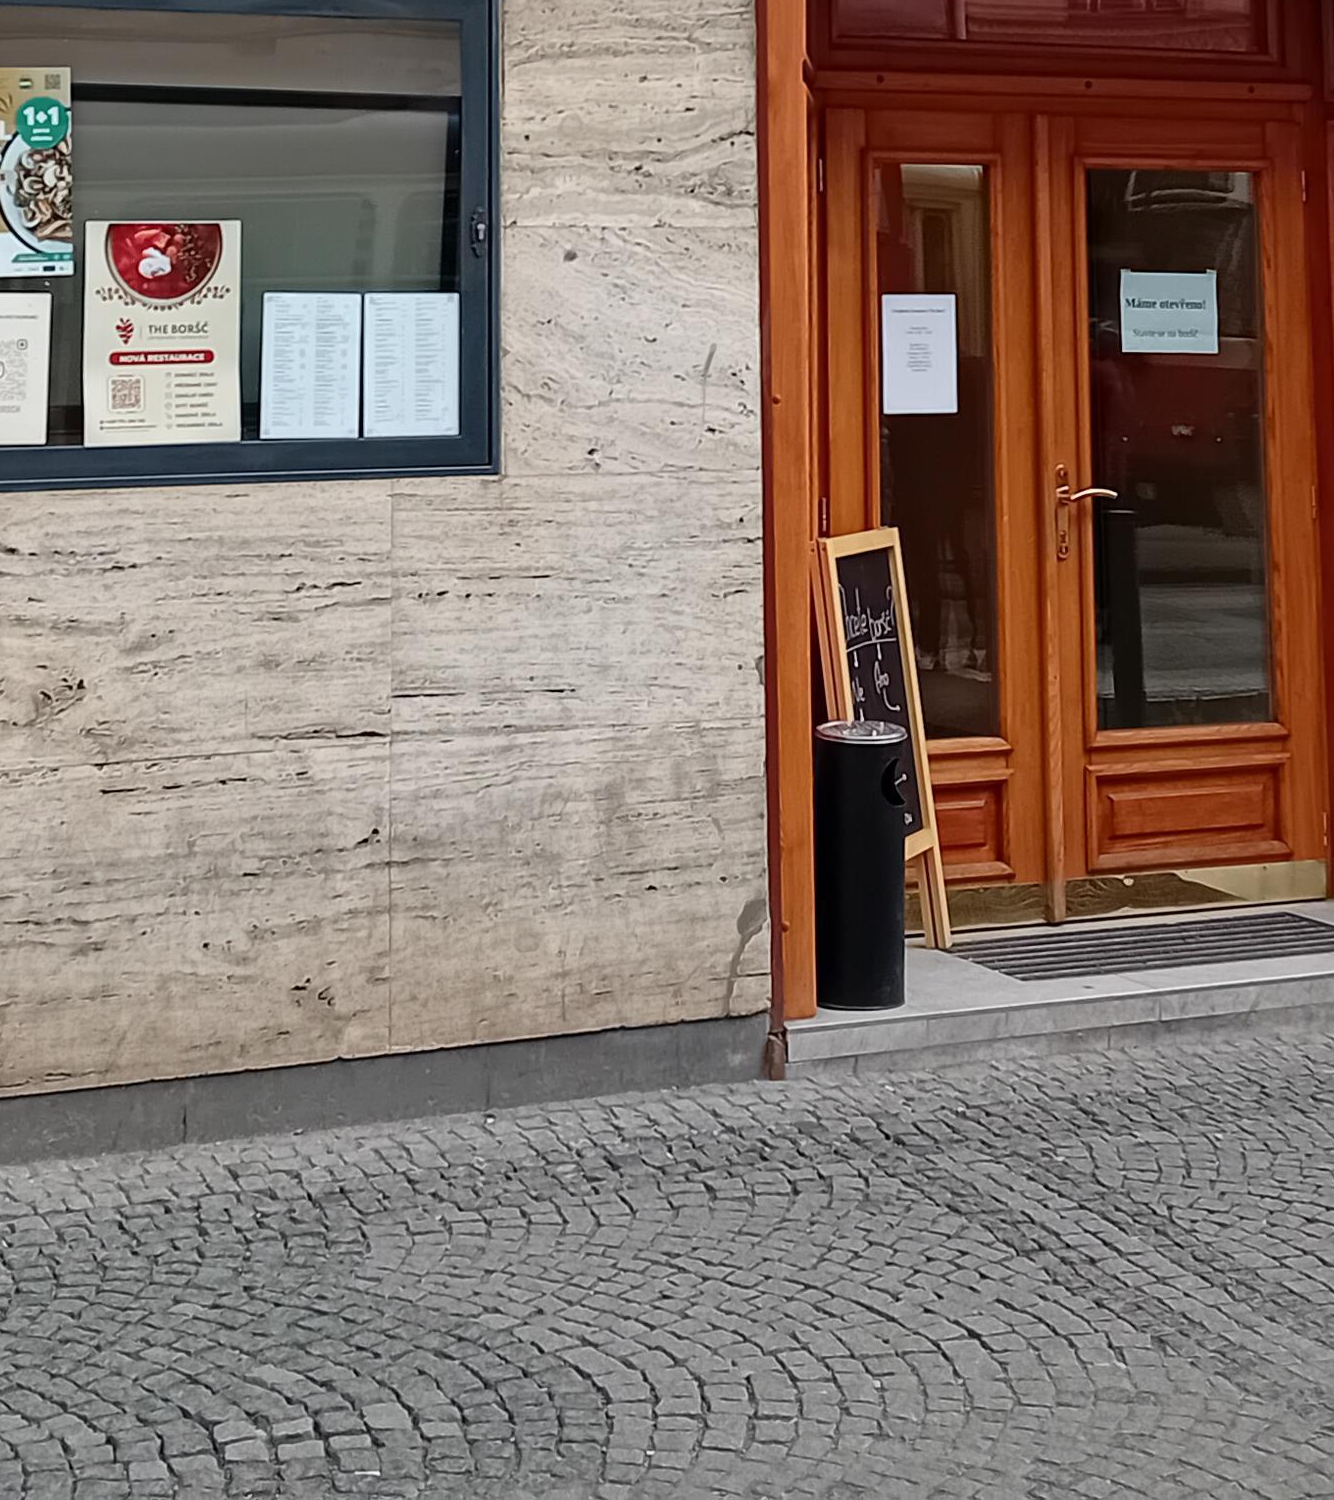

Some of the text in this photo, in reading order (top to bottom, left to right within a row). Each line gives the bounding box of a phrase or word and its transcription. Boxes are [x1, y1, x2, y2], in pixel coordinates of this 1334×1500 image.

[148, 324, 168, 335] THE
[118, 352, 206, 363] NOVÁ RESTAURACE
